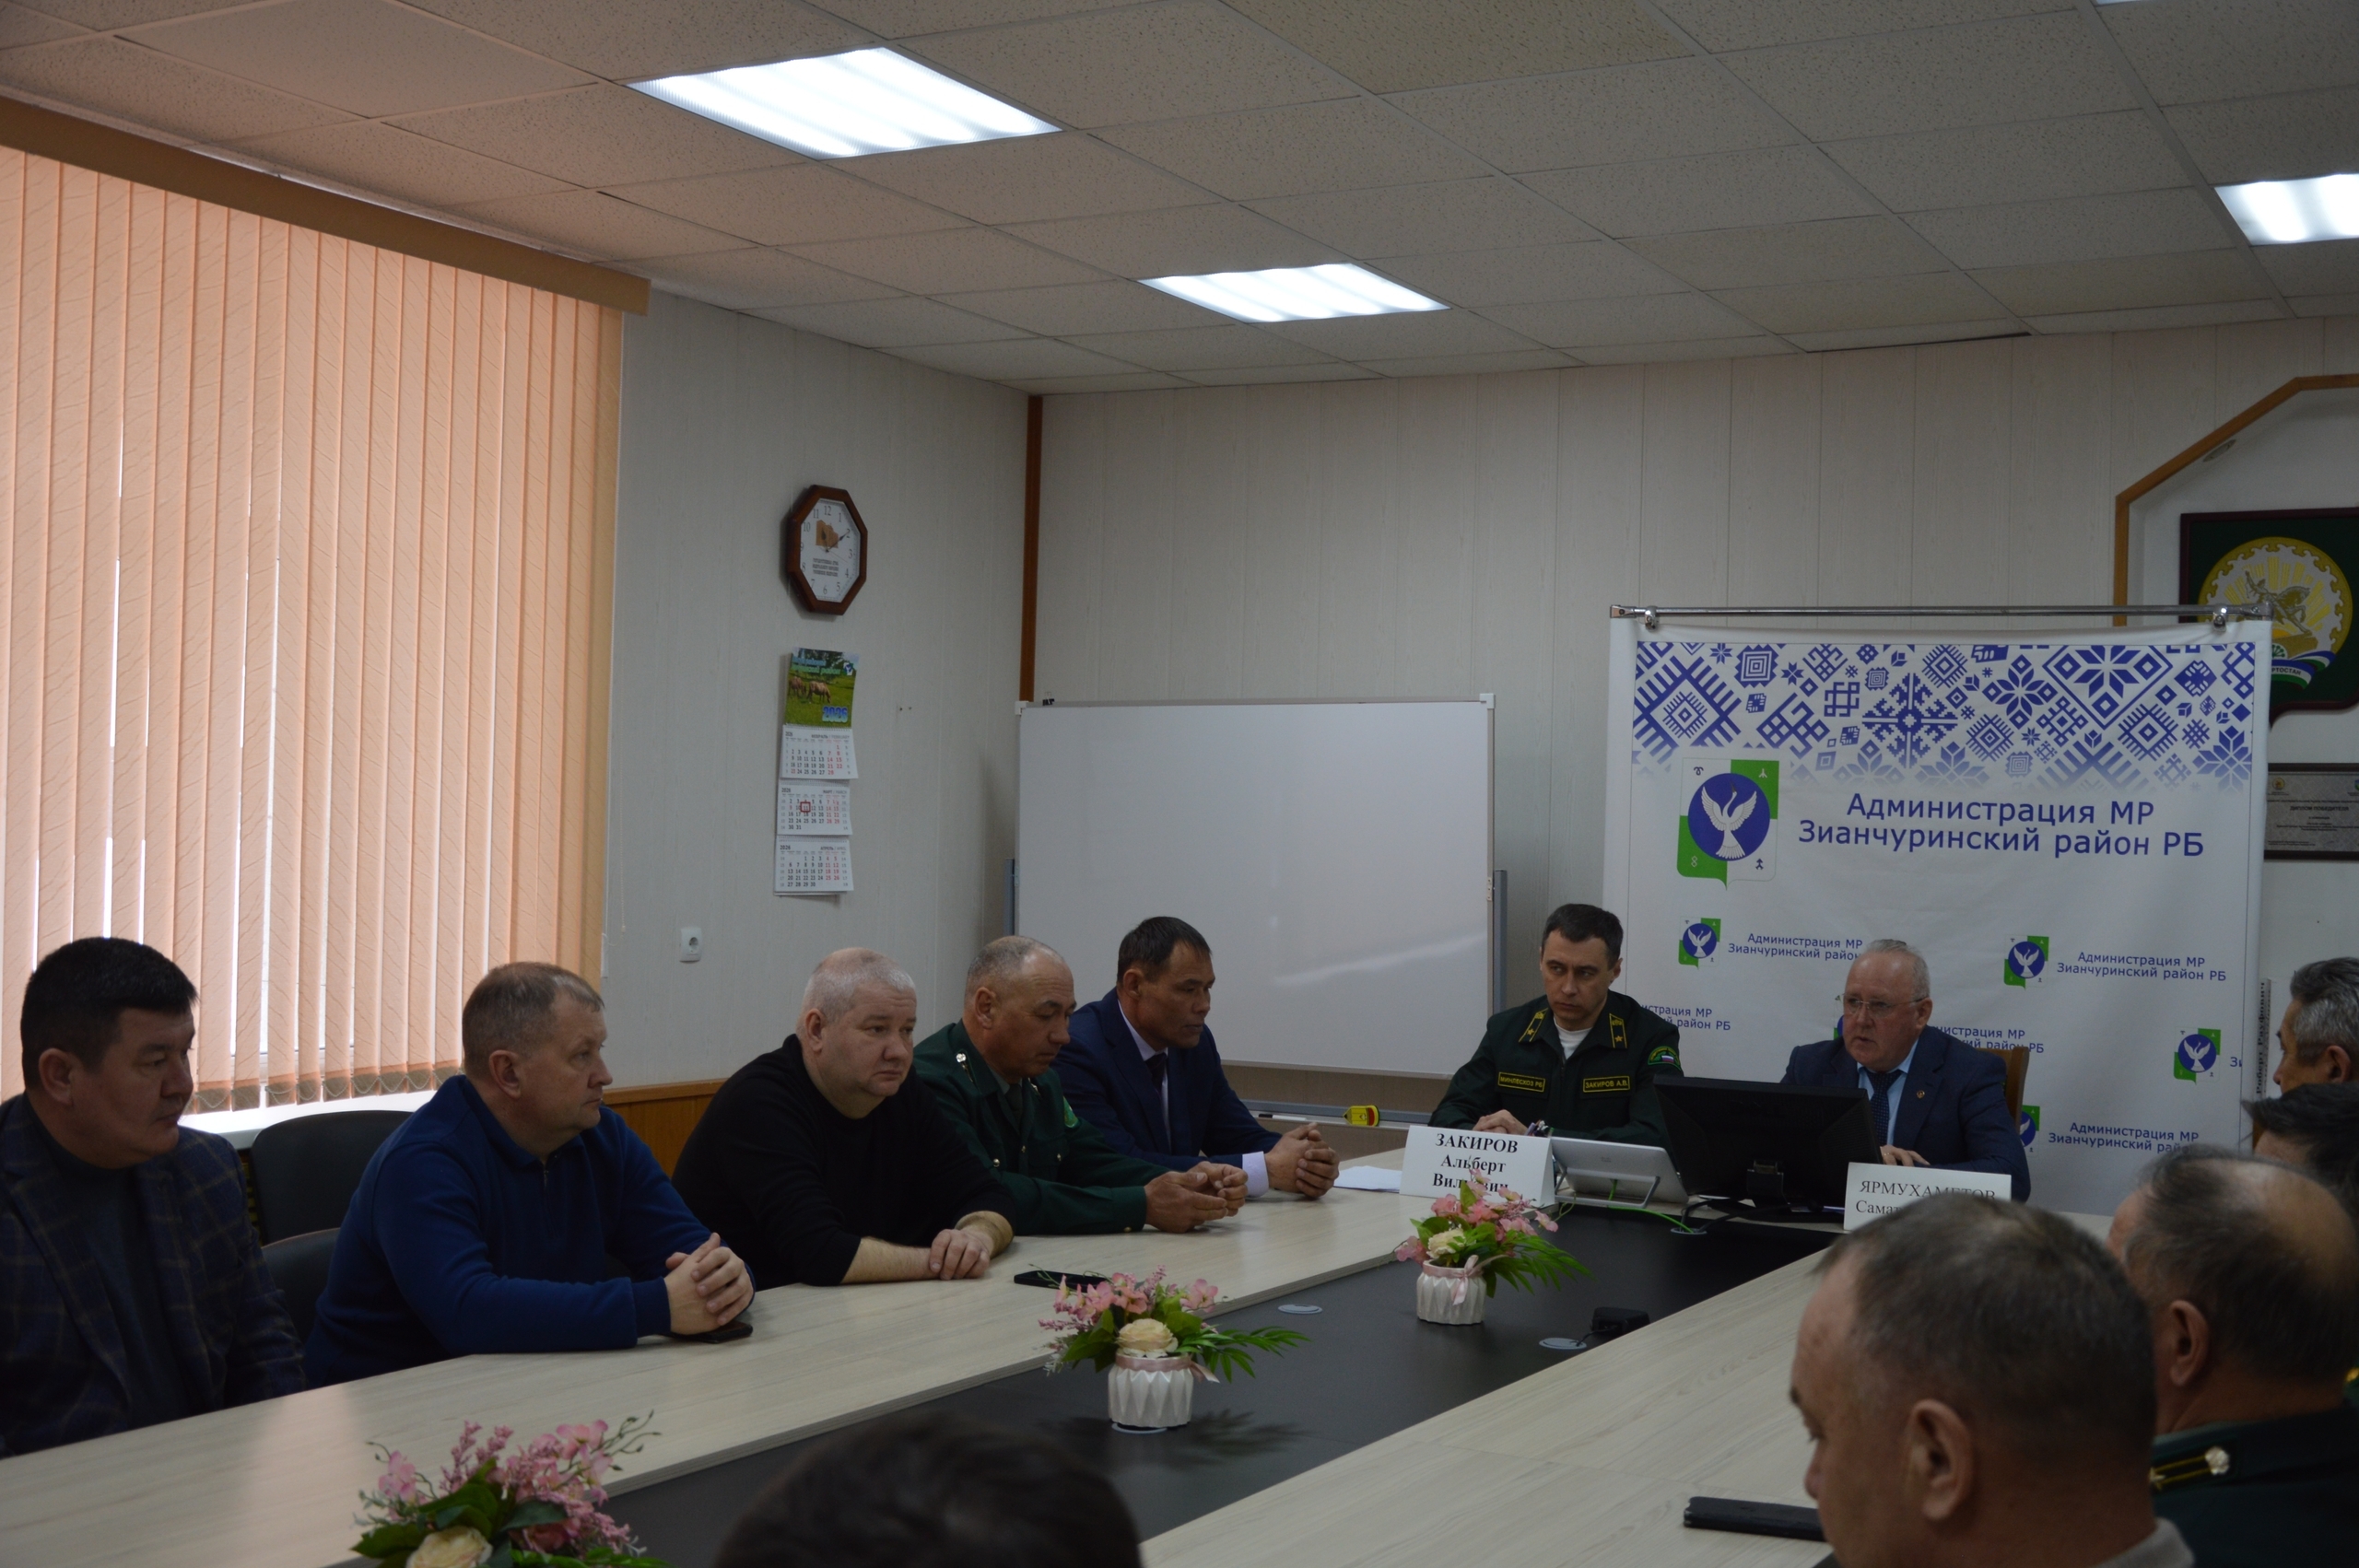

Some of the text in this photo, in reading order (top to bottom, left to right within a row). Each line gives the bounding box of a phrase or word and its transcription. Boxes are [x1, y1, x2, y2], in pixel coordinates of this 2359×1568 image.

[813, 509, 819, 519] 11
[824, 506, 831, 516] 12
[804, 521, 811, 532] 10
[2271, 667, 2301, 675] РТОСТАН
[822, 707, 848, 722] 2026
[1847, 793, 2154, 825] Администрация МР
[1798, 820, 2204, 858] Зианчуринский район РБ
[1747, 933, 1863, 949] Администрация МР
[1728, 943, 1820, 959] Зианчуринский
[2077, 952, 2205, 967] Администрация МР
[2057, 963, 2226, 981] Зианчуринский район РБ
[1696, 1008, 1712, 1018] МР
[1677, 1018, 1711, 1029] район
[1716, 1021, 1731, 1031] РБ
[2008, 1029, 2025, 1039] МР
[2256, 982, 2266, 1094] Роберт Рауфович
[2028, 1043, 2045, 1053] РБ
[1500, 1076, 1534, 1087] МИНЛЕСХОЗ
[1585, 1080, 1614, 1089] ЗАКИРОВ
[2070, 1122, 2199, 1142] Администрация МР
[1436, 1133, 1519, 1153] ЗАКИРОВ
[2048, 1133, 2152, 1151] Зианчуринский
[1440, 1154, 1507, 1175] Альберт
